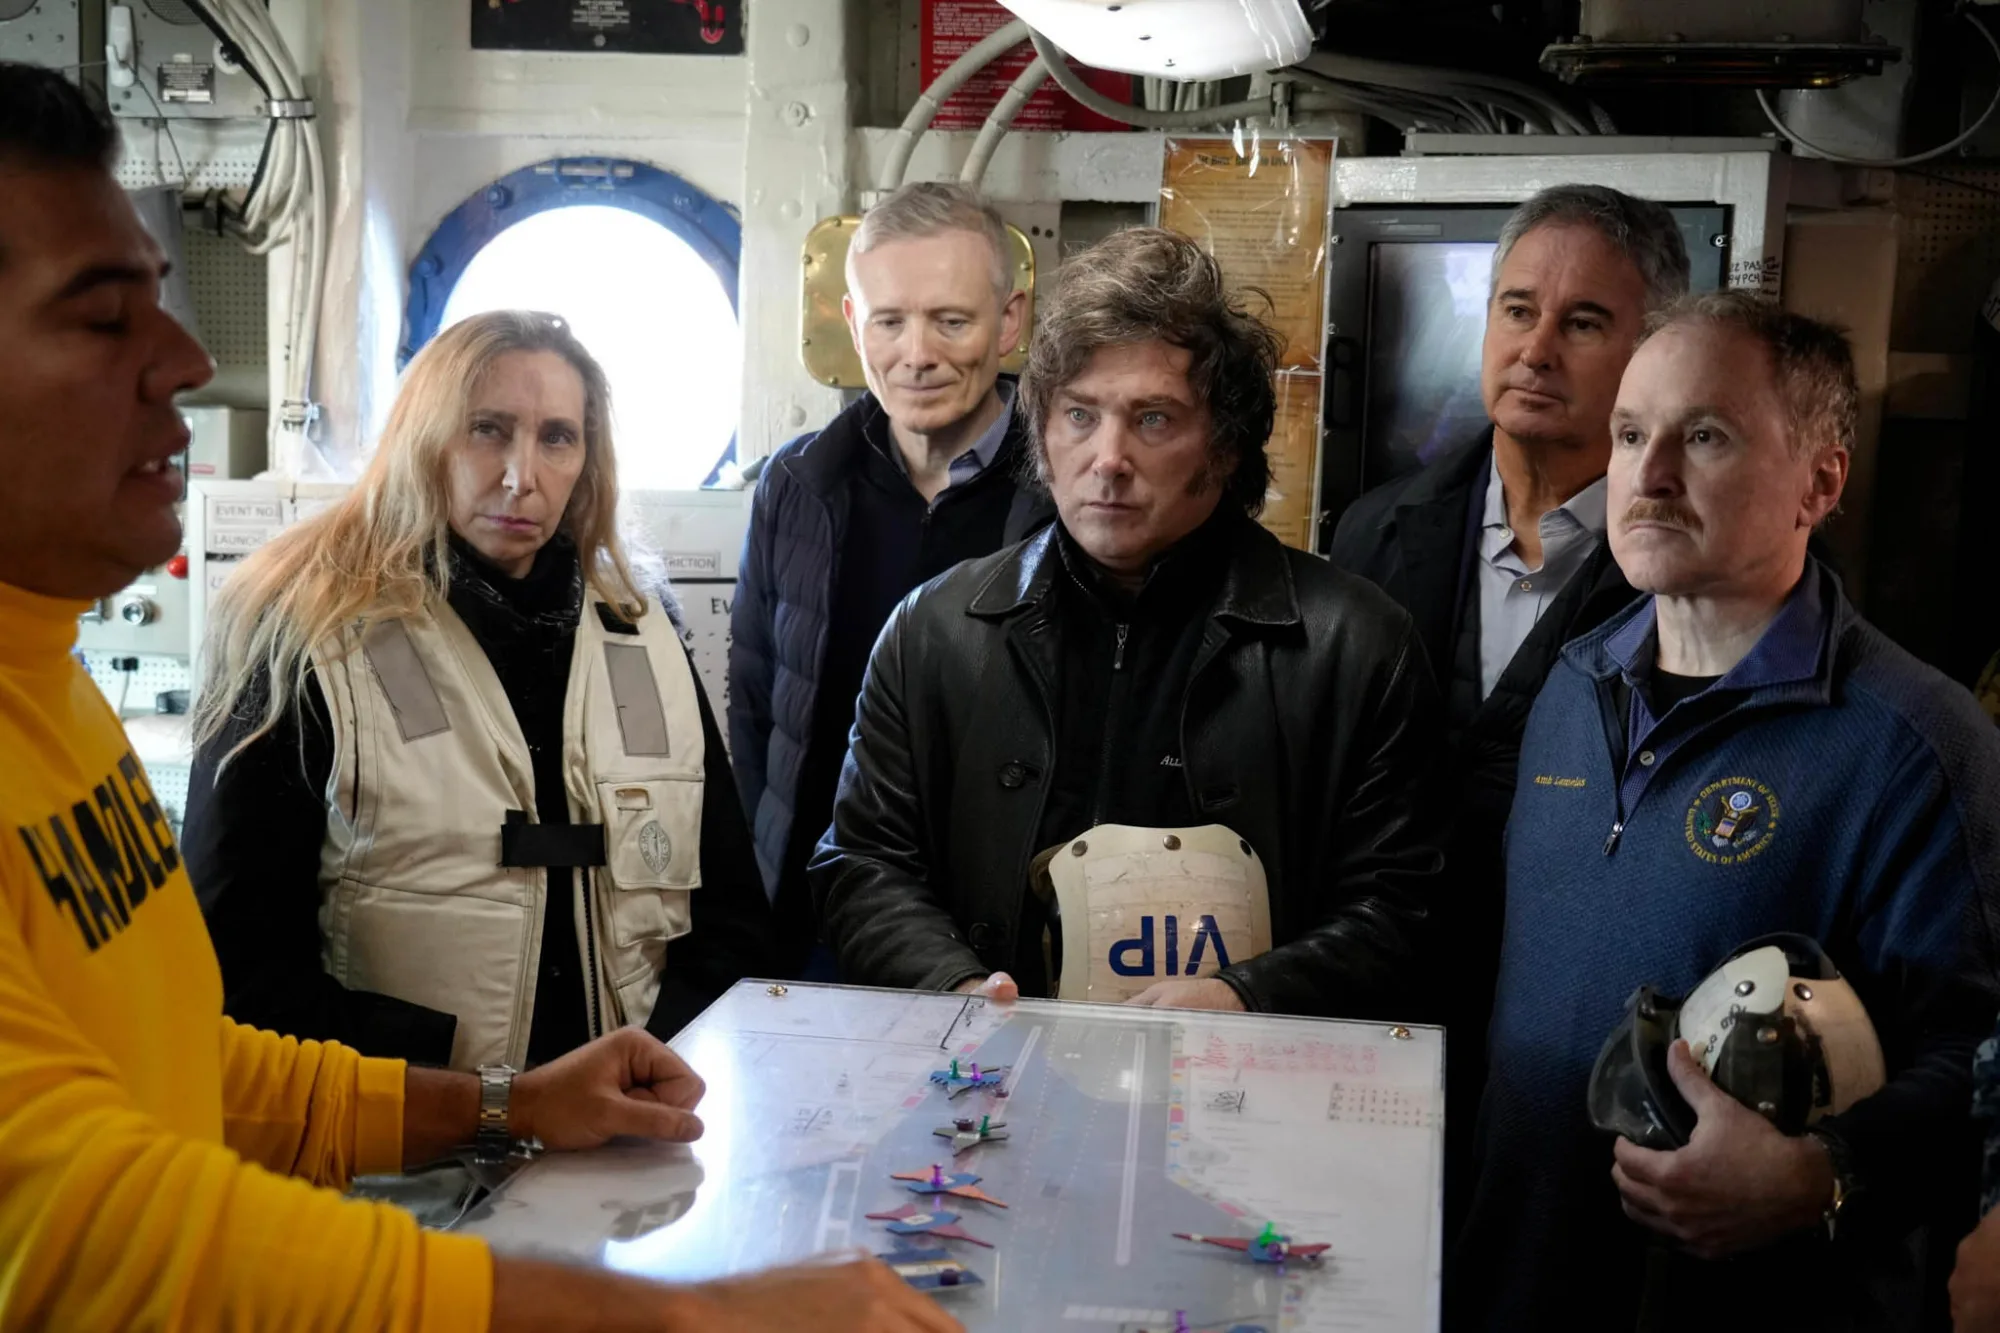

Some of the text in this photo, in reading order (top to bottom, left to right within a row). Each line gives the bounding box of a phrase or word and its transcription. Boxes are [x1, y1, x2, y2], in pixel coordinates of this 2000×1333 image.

[1700, 777, 1757, 799] DEPARTMENT
[1685, 807, 1697, 842] UNITED
[1690, 841, 1718, 864] STATES
[1720, 855, 1735, 865] OF
[1109, 914, 1232, 977] VIP
